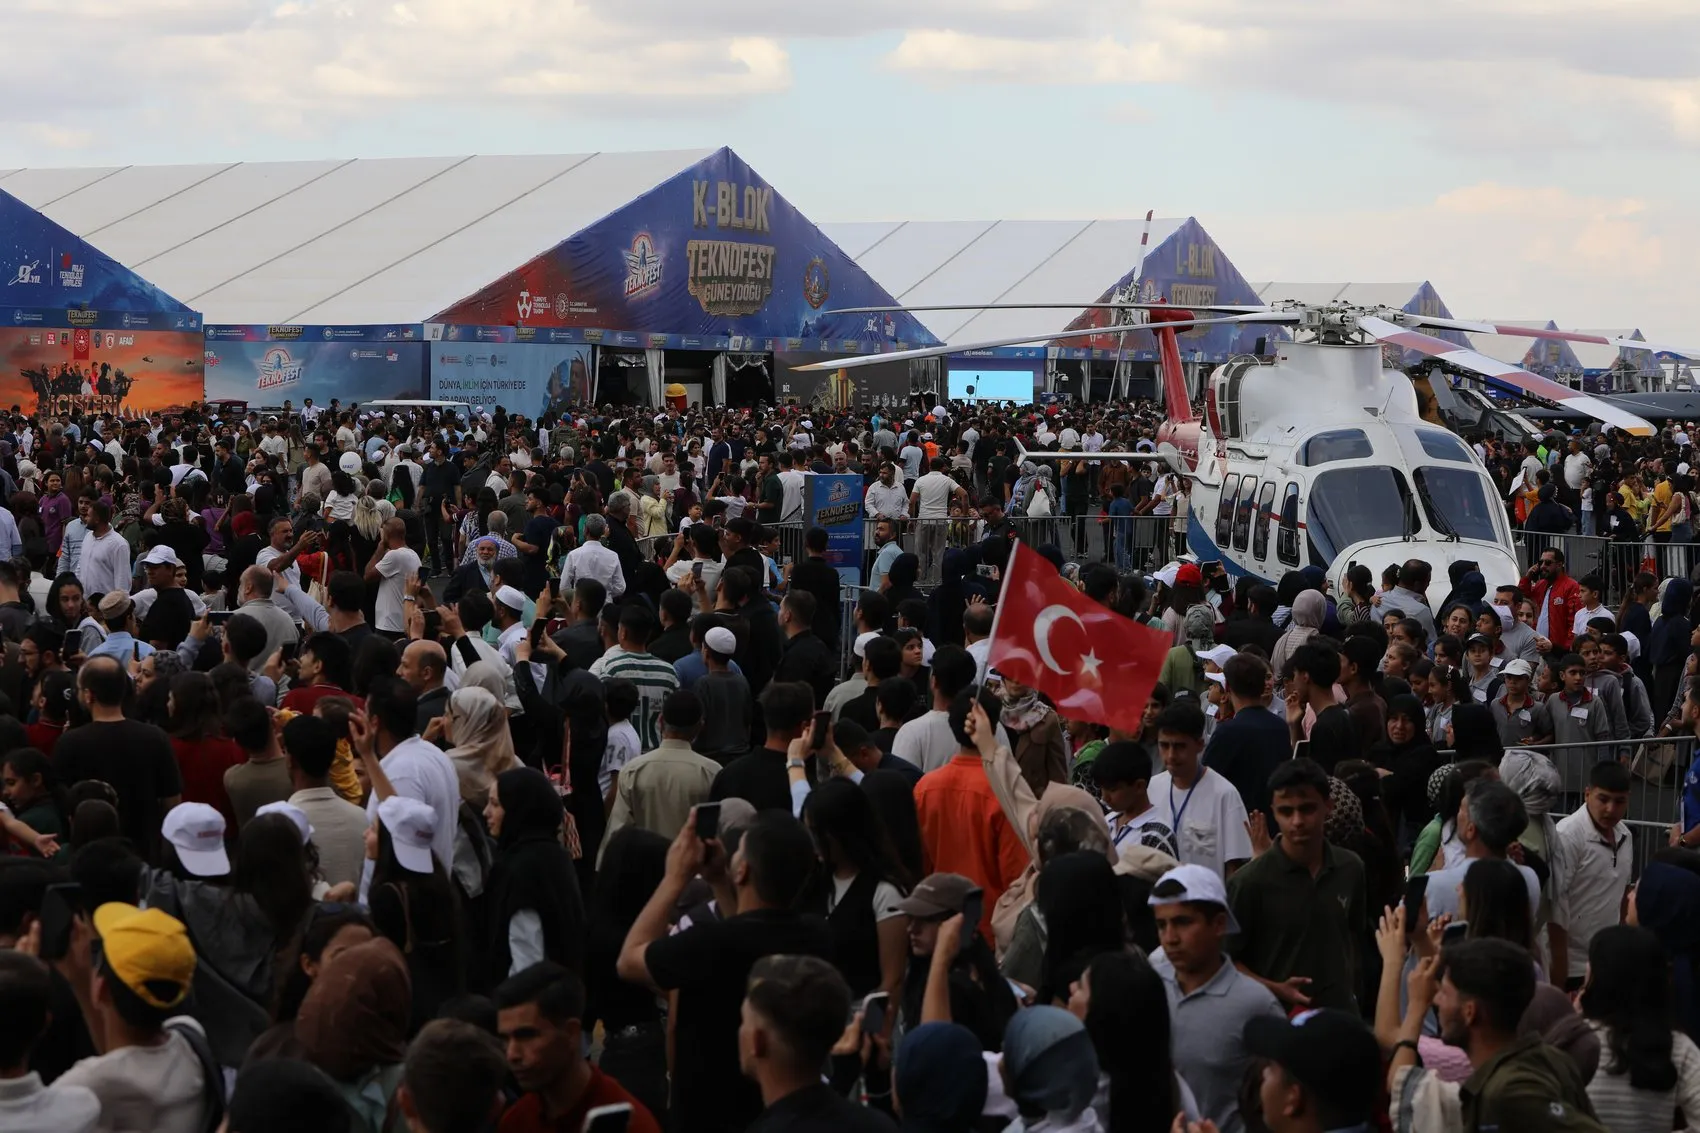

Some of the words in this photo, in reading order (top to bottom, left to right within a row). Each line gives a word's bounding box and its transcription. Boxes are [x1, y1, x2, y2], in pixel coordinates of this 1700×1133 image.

[693, 180, 770, 232] K-BLOK
[687, 240, 776, 279] TEKNOFEST
[1176, 243, 1215, 277] L-BLOK
[625, 263, 662, 295] TEKNOFEST
[704, 280, 762, 302] GÜNEYDOĞU
[67, 309, 98, 320] TEKNOFEST
[267, 325, 304, 334] TEKNOFEST
[258, 367, 302, 389] TEKNOFEST
[471, 393, 497, 405] GELİYOR
[817, 502, 859, 519] TEKNOFEST
